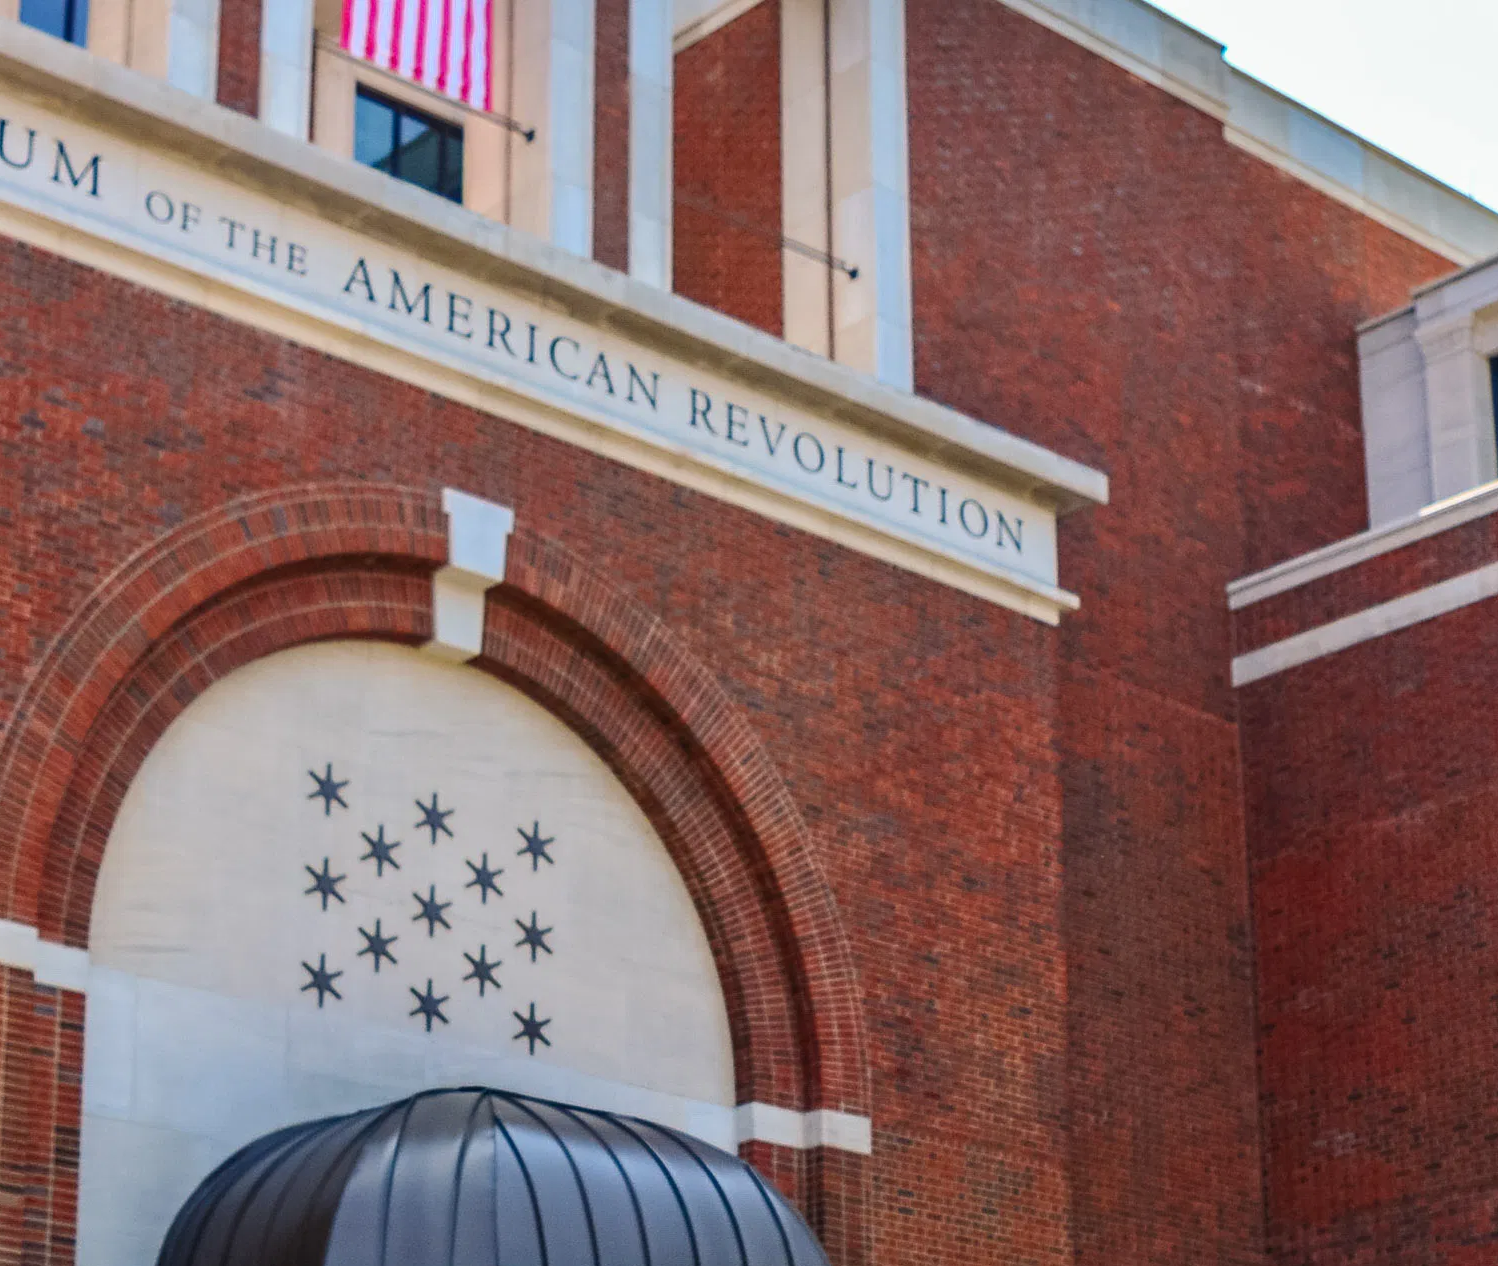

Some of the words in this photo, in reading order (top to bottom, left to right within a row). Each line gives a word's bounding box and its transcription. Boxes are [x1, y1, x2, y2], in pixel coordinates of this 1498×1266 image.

[144, 190, 201, 234] OF
[217, 215, 309, 276] THE
[343, 257, 663, 411] AMERICAN
[687, 387, 1026, 555] REVOLUTION
